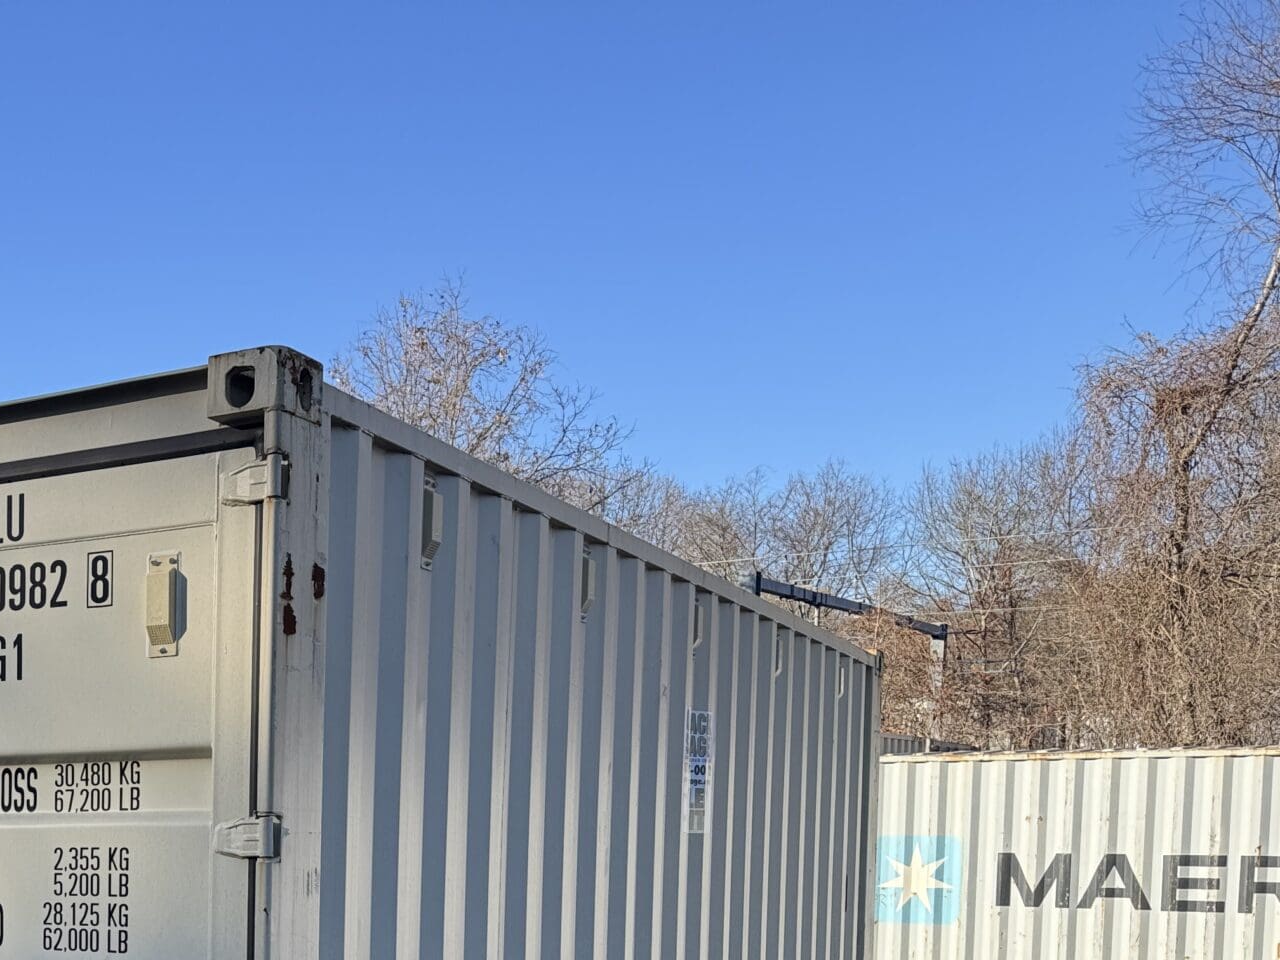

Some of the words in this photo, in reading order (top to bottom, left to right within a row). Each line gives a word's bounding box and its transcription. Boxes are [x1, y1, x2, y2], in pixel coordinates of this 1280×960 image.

[90, 555, 109, 604] 8
[54, 762, 112, 789] 30,480
[119, 760, 141, 785] KG
[54, 788, 112, 814] 67,200
[119, 786, 140, 811] LB
[53, 847, 100, 873] 2,355
[108, 847, 129, 871] KG
[53, 873, 100, 898] 5,200
[108, 873, 129, 898] LB
[42, 902, 100, 928] 28,125
[107, 903, 129, 928] KG
[42, 928, 100, 953] 62,000
[107, 929, 128, 954] LB
